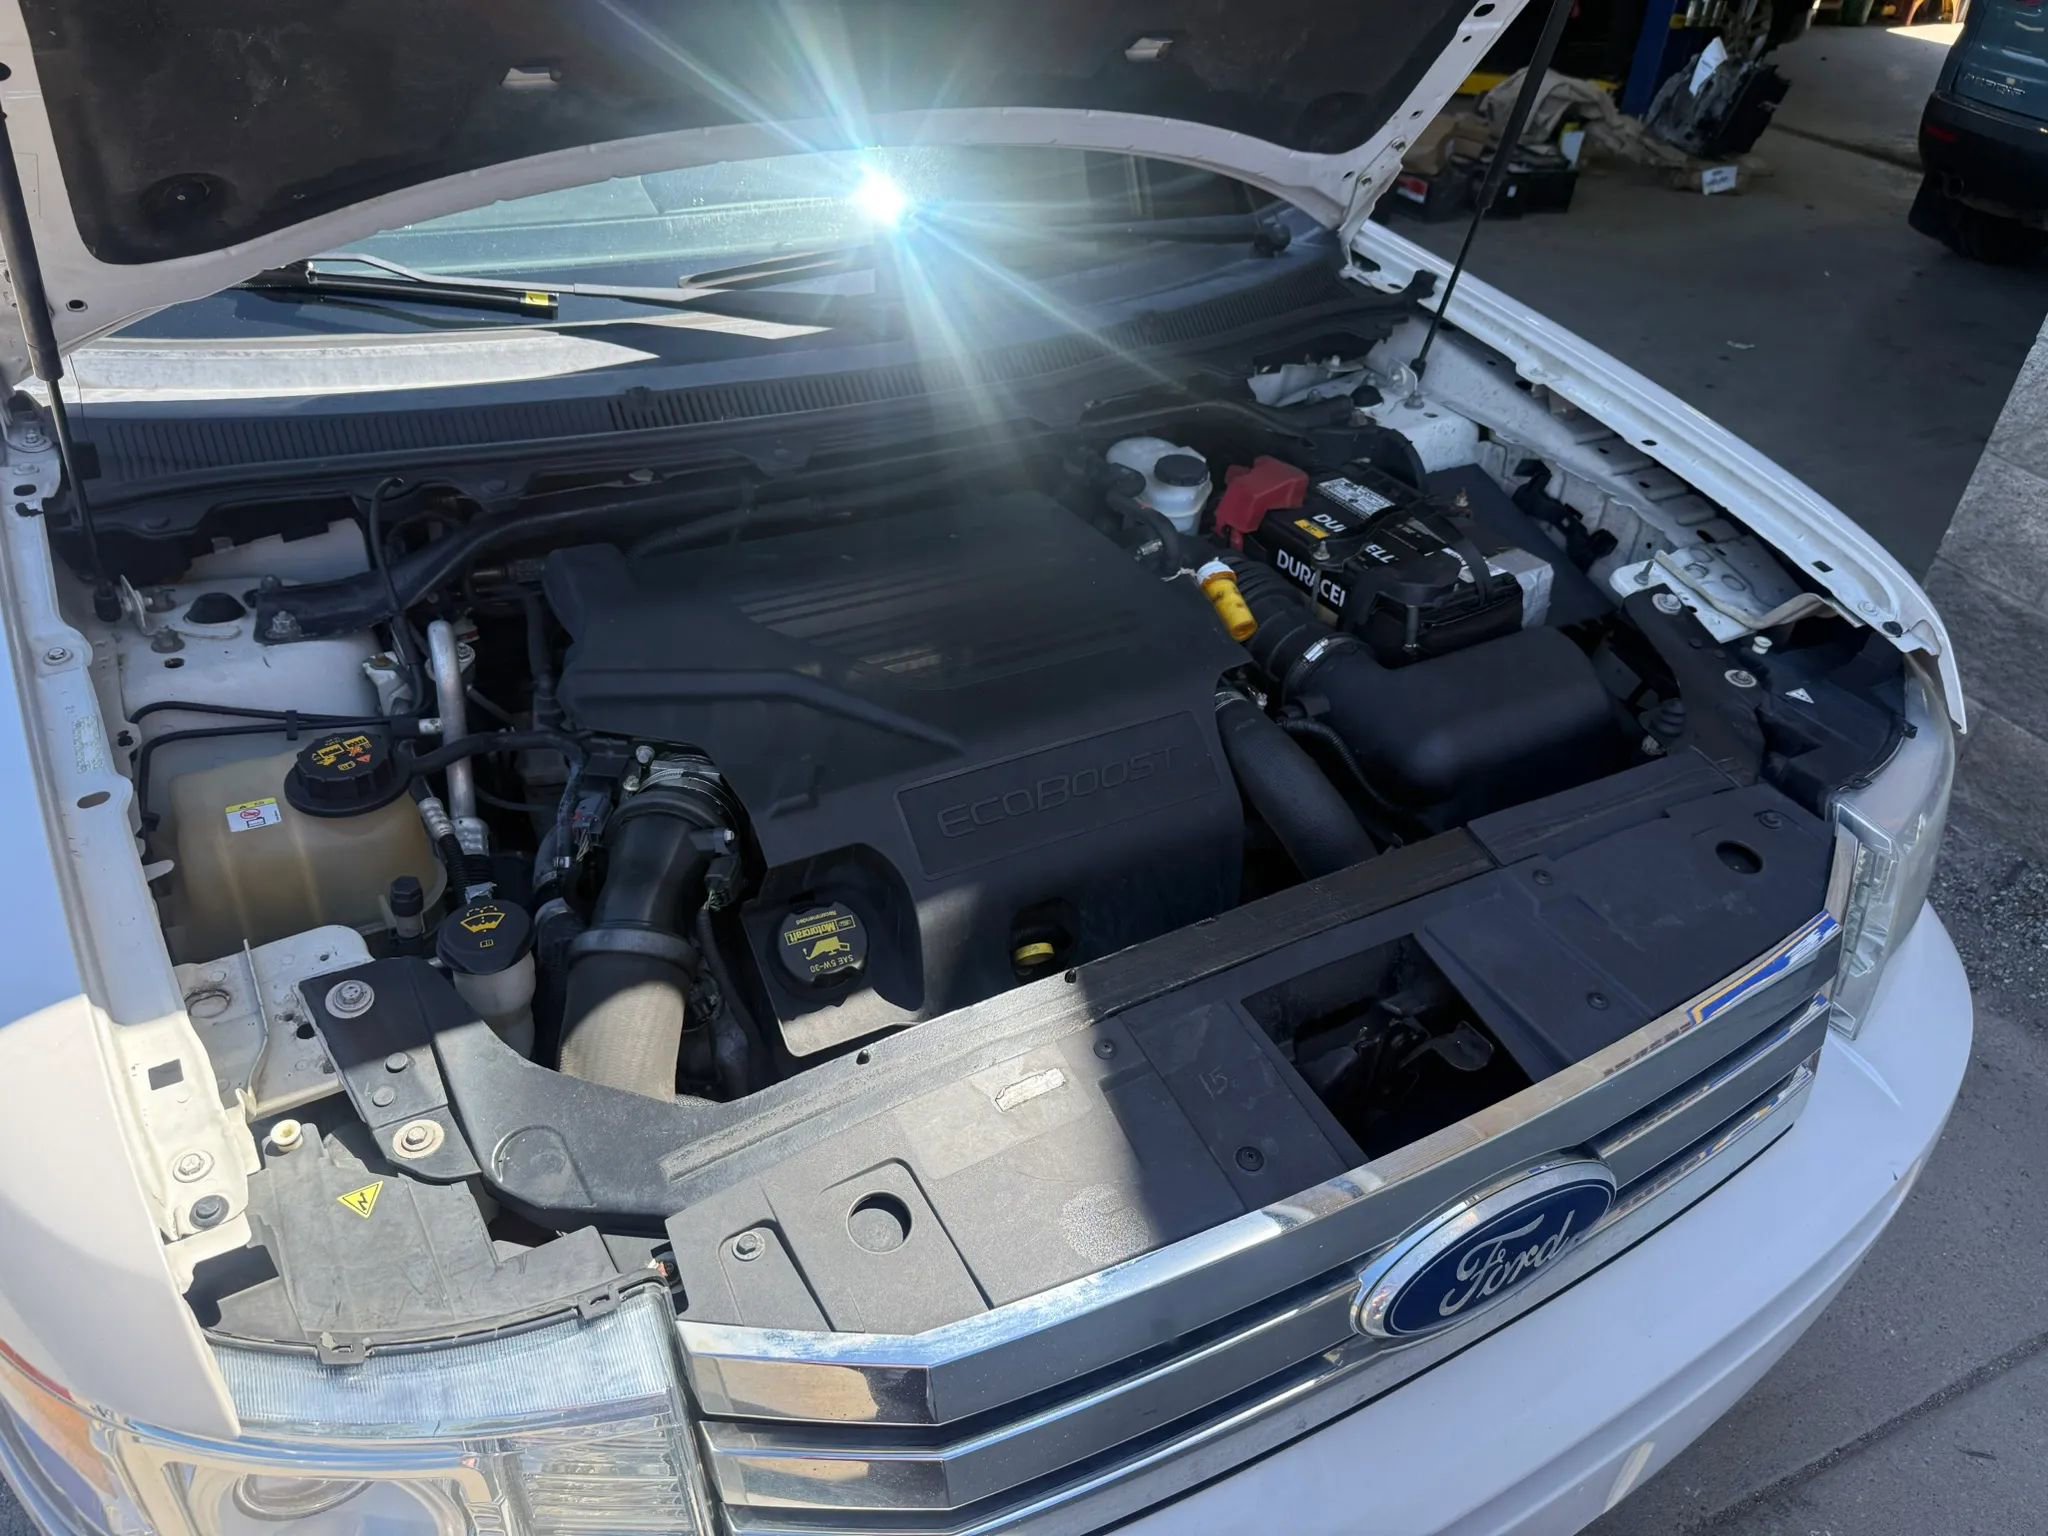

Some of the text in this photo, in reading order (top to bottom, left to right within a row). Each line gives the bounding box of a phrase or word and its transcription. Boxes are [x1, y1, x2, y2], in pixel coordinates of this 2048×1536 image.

[788, 920, 836, 943] Motorcraft
[810, 954, 854, 973] SAE 5W-30
[1438, 1209, 1576, 1317] Ford
